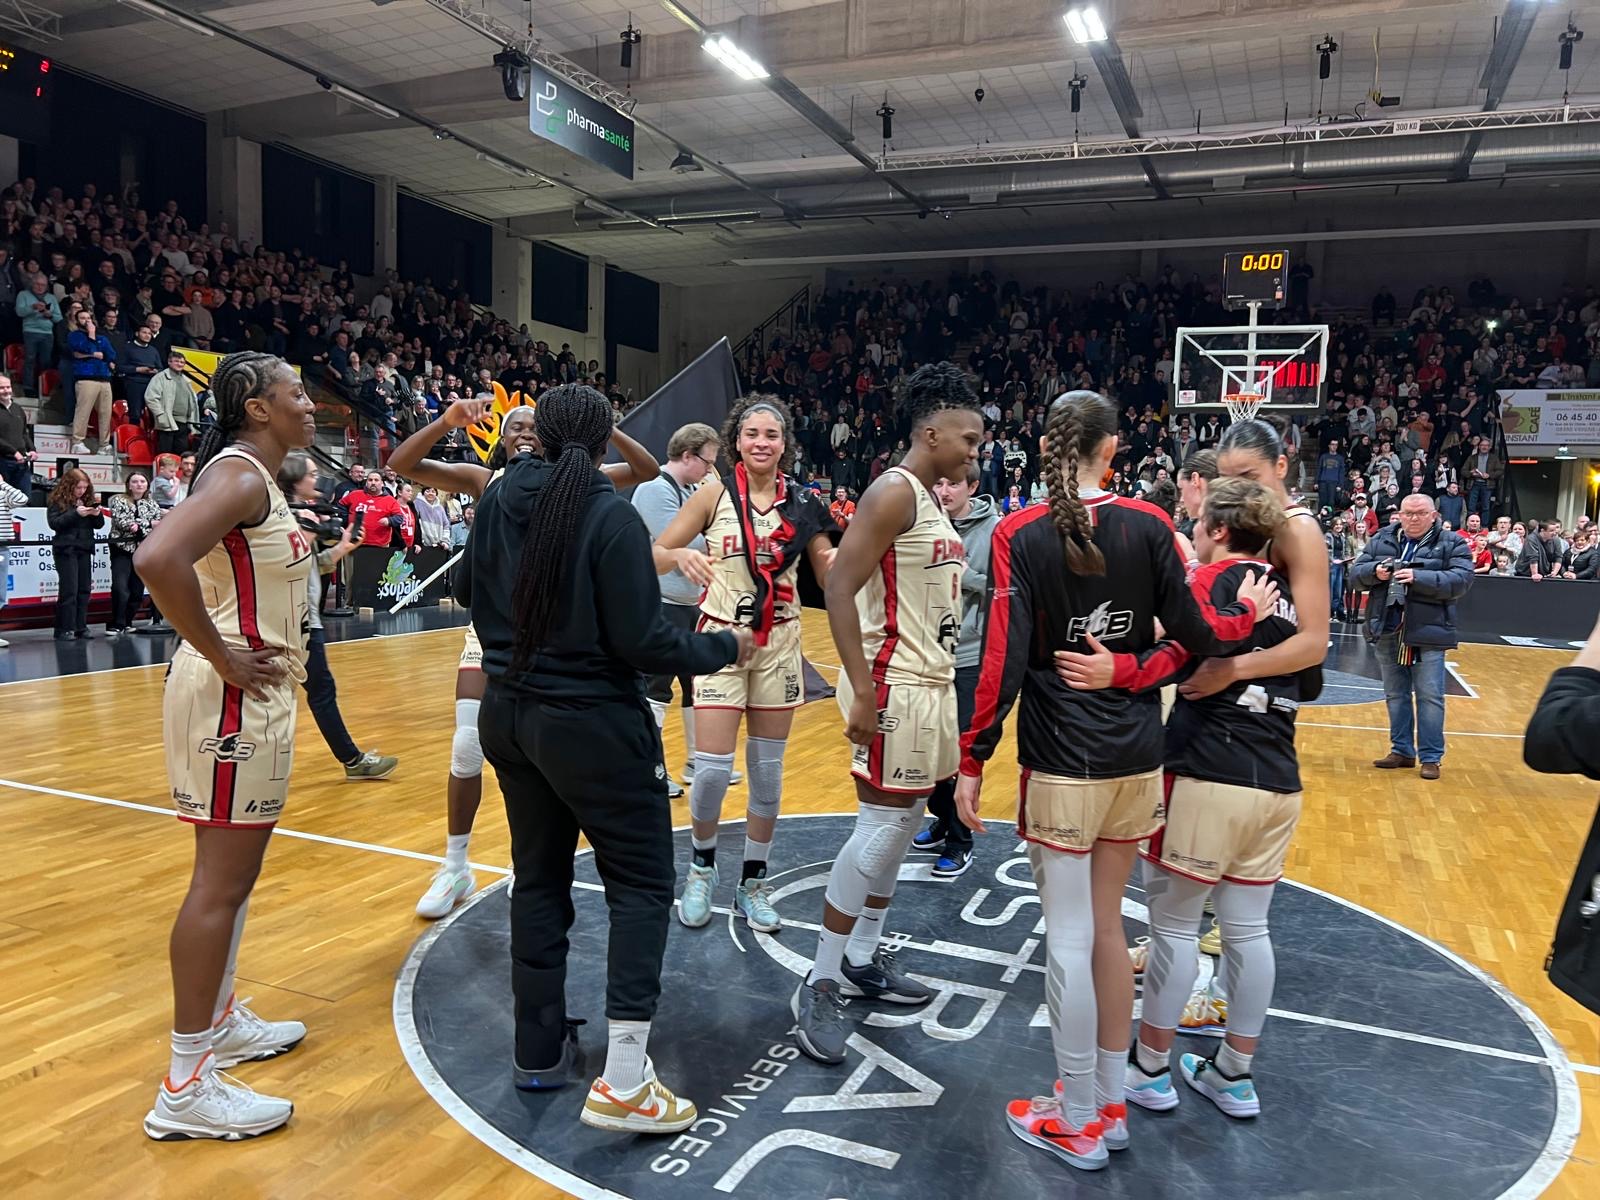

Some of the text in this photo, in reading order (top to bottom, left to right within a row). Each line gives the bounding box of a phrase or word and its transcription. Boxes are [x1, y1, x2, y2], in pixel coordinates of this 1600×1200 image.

[567, 108, 630, 152] pharmasanté
[1241, 253, 1283, 271] 0:00
[1556, 413, 1598, 421] 06 45 40
[38, 548, 52, 556] Co
[287, 528, 310, 561] FL
[650, 1043, 800, 1176] SERVICES
